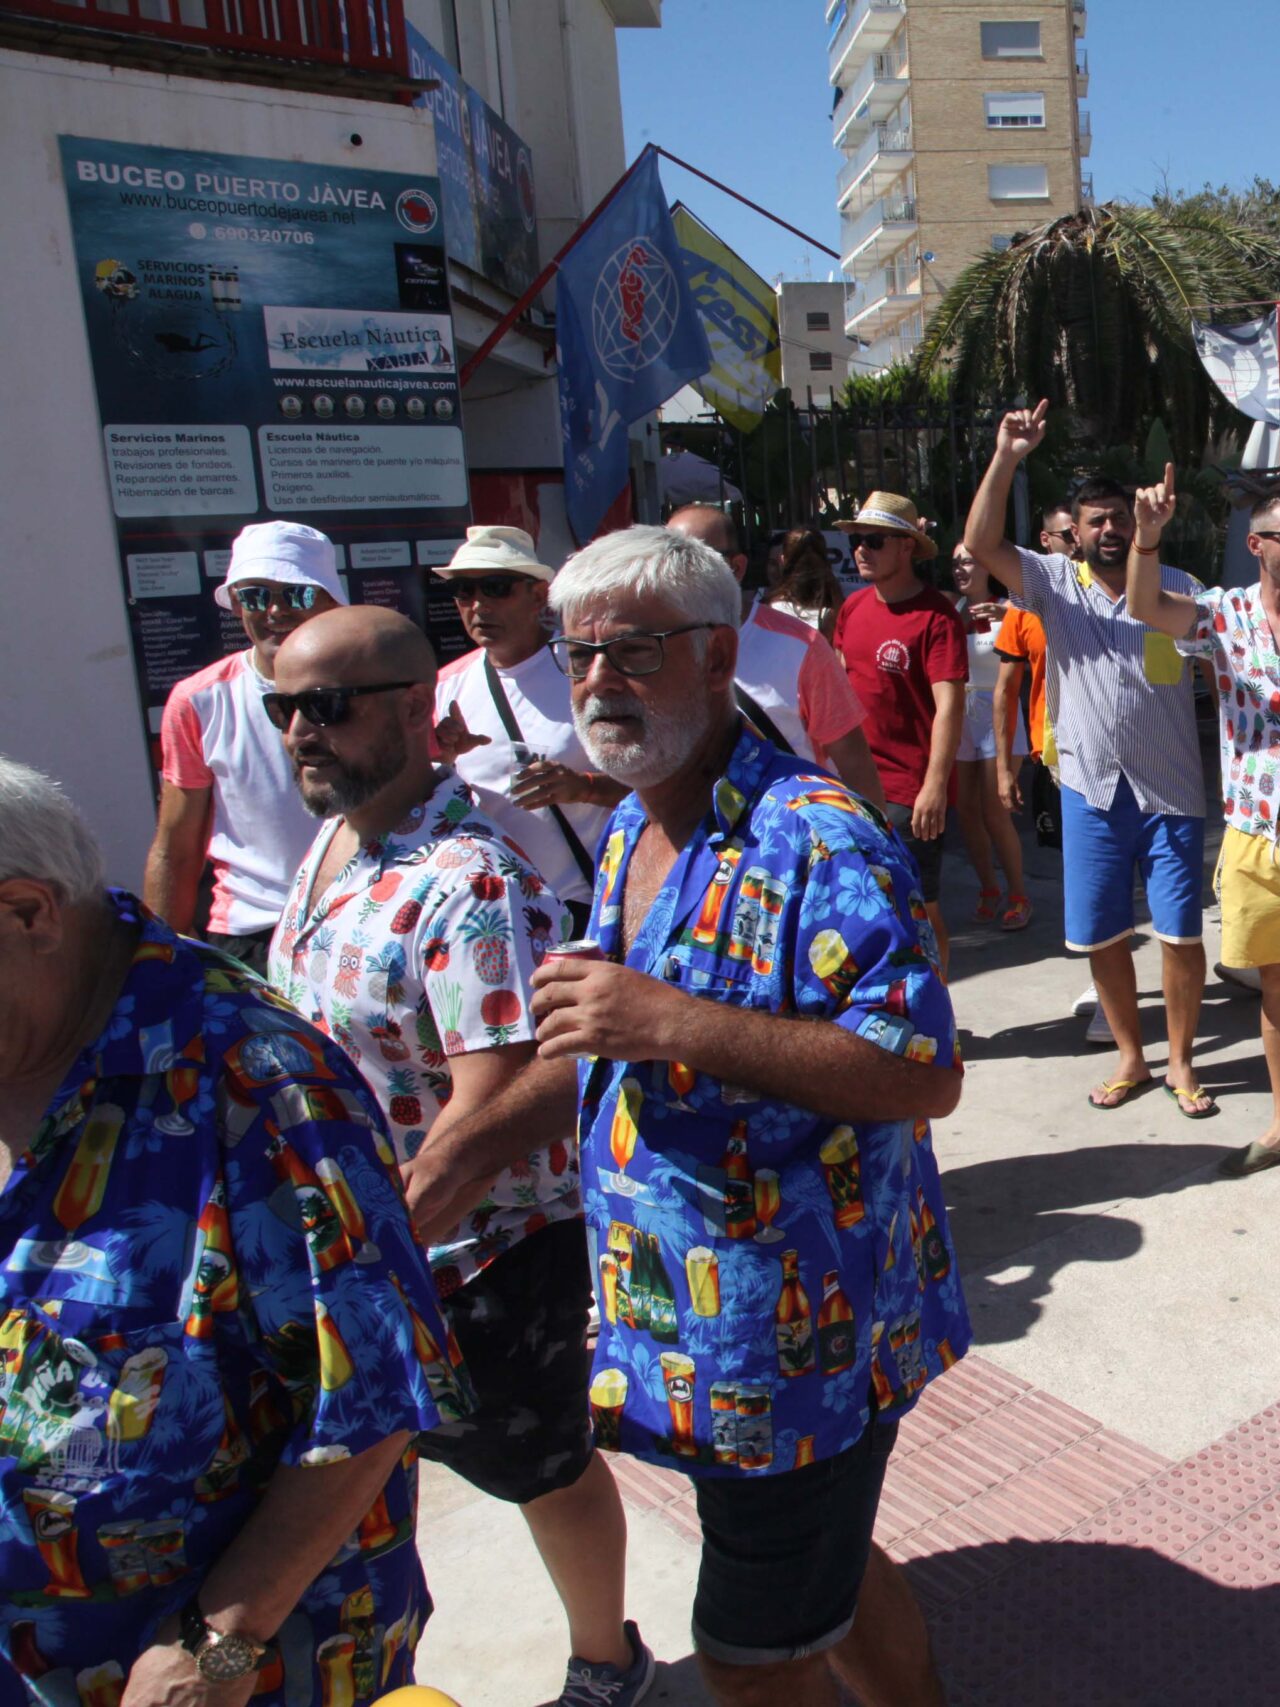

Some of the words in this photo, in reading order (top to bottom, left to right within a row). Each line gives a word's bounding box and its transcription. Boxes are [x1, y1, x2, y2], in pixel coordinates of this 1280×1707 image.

[76, 160, 186, 190] BUCEO
[194, 173, 300, 201] PUERTO
[308, 182, 386, 210] JÀVEA
[119, 192, 356, 225] www.buceopuertodejavea.net
[214, 226, 314, 244] 690320706
[137, 260, 205, 274] SERVICIOS
[144, 273, 205, 287] MARINOS
[148, 289, 201, 301] ALAGUA
[280, 330, 360, 350] Escuela
[366, 326, 442, 346] Náutica
[273, 377, 456, 391] www.escuelanauticajavea.com
[110, 433, 172, 443] Servicios
[175, 433, 226, 443] Marinos
[266, 432, 313, 441] Escuela
[316, 431, 360, 441] Náutica
[114, 460, 172, 470] Revisiones
[175, 461, 188, 469] de
[180, 474, 193, 482] de
[184, 487, 197, 496] de
[22, 1359, 74, 1416] PIÑA
